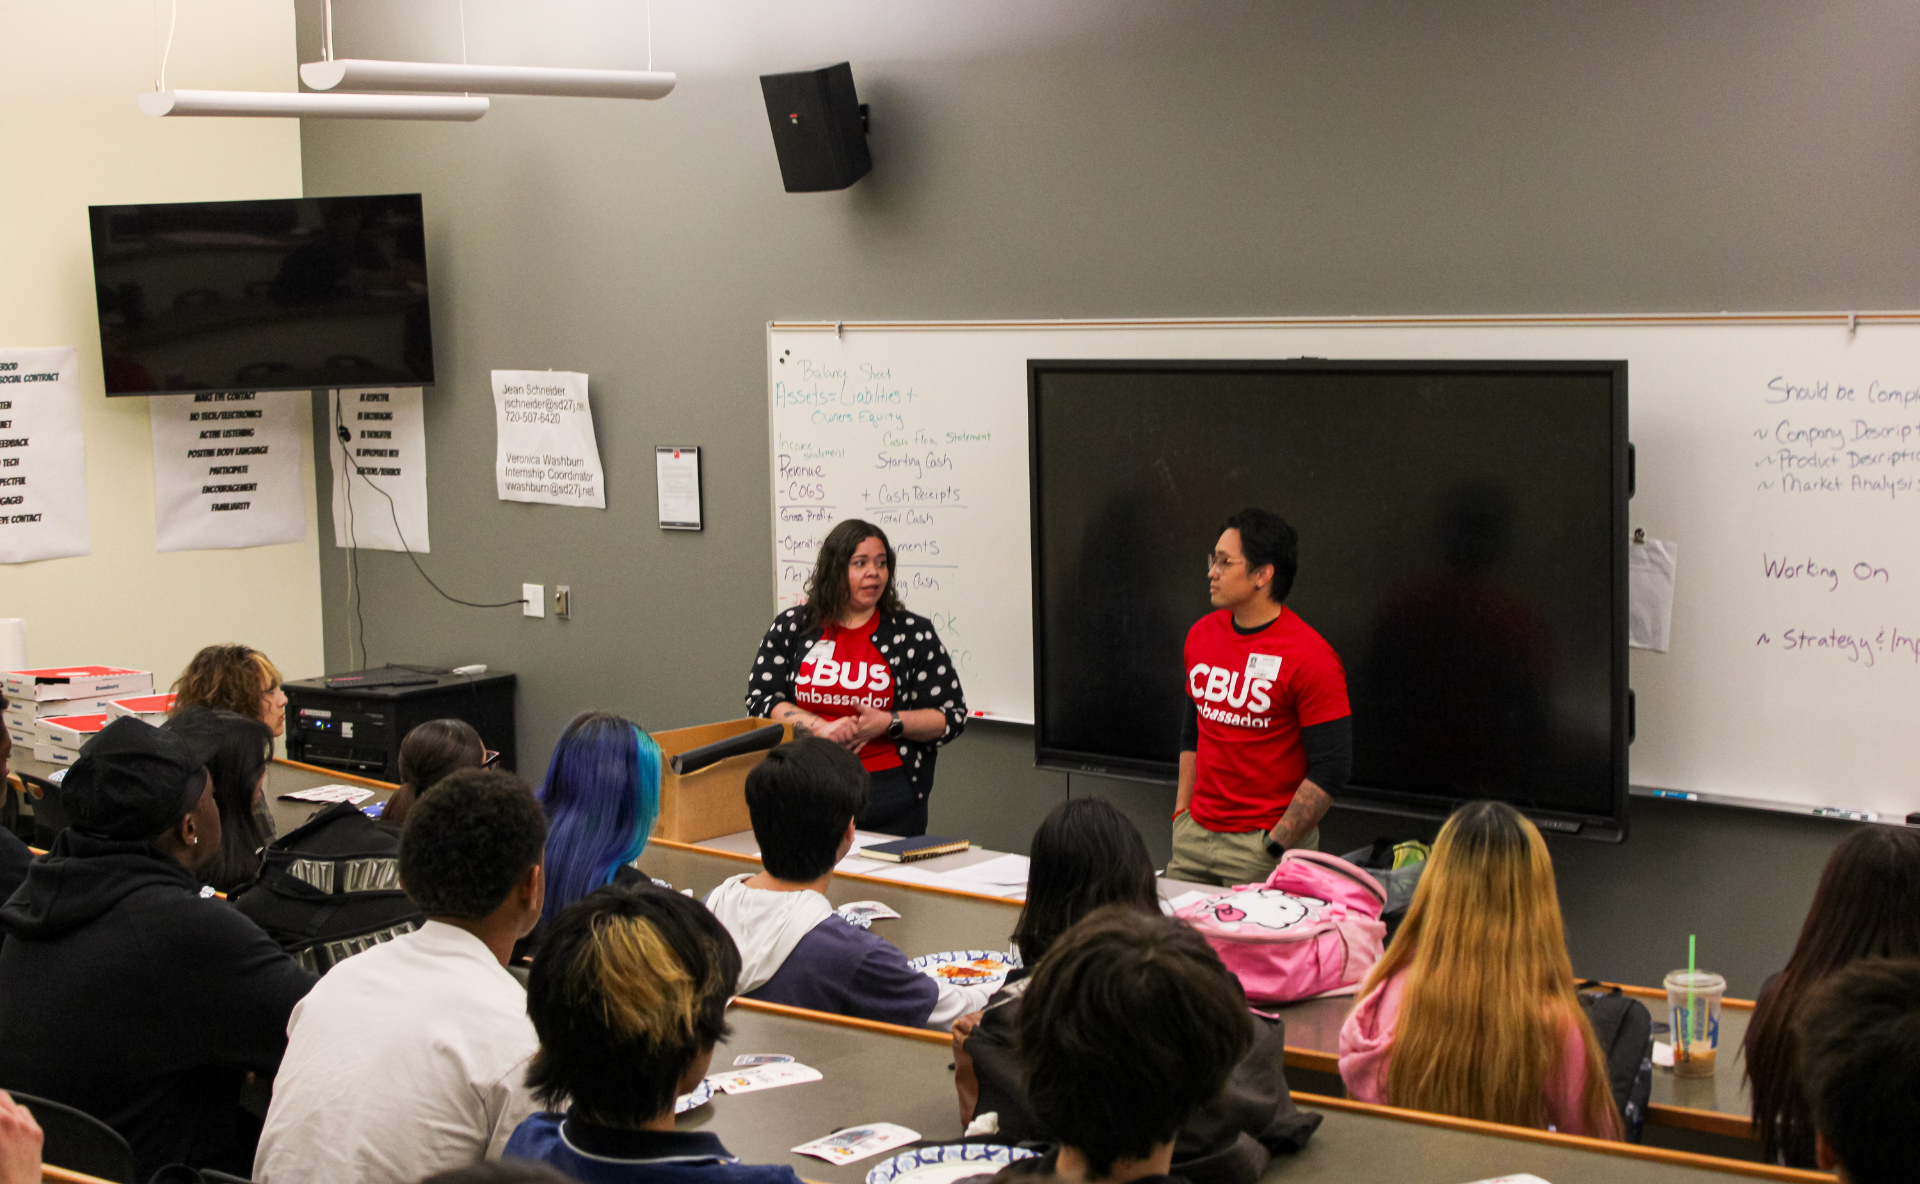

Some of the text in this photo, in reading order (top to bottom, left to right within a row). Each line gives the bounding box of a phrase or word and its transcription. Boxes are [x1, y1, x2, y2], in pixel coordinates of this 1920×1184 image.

[24, 373, 59, 383] CONTRACT
[797, 359, 892, 381] Balance Sheet
[227, 391, 256, 401] CONTACT
[503, 384, 566, 396] Jean Schneider
[1764, 375, 1920, 409] Should be Compl
[190, 412, 199, 421] NO
[505, 411, 561, 424] 720-507-6420
[811, 409, 905, 431] Owners Equity
[200, 428, 254, 439] ACTIVE LISTENING
[778, 432, 813, 451] Income
[882, 430, 908, 447] Cash
[945, 431, 992, 445] Statement
[1775, 419, 1846, 451] Company
[188, 445, 269, 458] POSITIVE BODY LANGUAGE
[506, 453, 584, 467] Veronica Washburn
[1777, 447, 1840, 471] Product
[209, 465, 249, 475] PARTICIPATE
[778, 454, 826, 480] Revenue
[875, 450, 953, 480] Starting Cash
[505, 467, 594, 482] Internship Coordinator
[1782, 472, 1843, 494] Market
[202, 483, 258, 494] ENCOURAGEMENT
[505, 481, 595, 498] vwashburn@sd27j.net
[878, 483, 909, 505] Cash
[912, 485, 960, 503] Receipts
[11, 514, 42, 524] CONTACT
[780, 507, 833, 522] Gross Profit
[873, 508, 934, 526] Total Cash
[778, 535, 825, 556] -Operatin
[1763, 551, 1890, 592] Working On
[913, 571, 940, 591] Cash
[1783, 627, 1875, 668] Strategy
[1189, 662, 1274, 714] CBUS
[1196, 700, 1272, 729] mbassador
